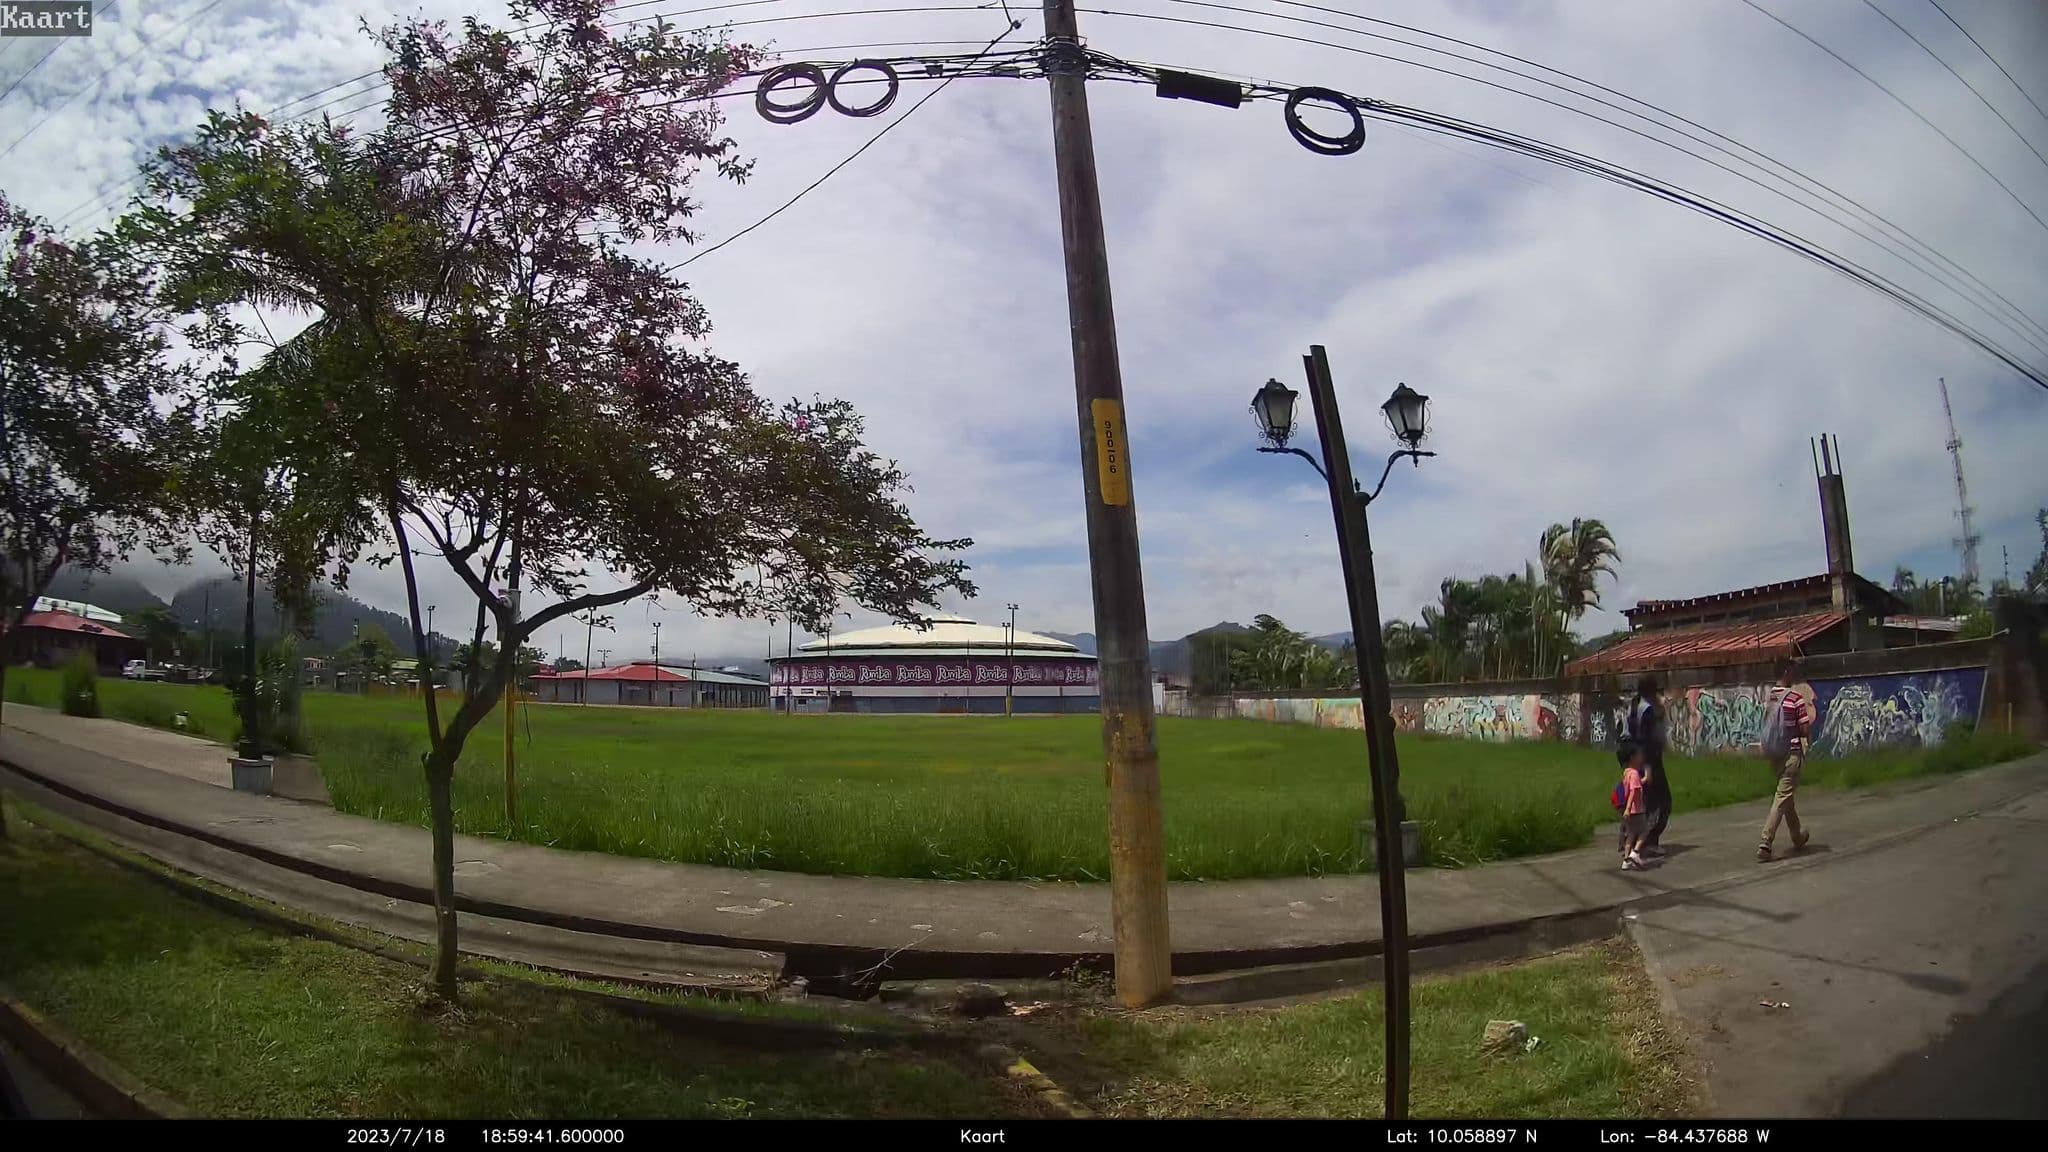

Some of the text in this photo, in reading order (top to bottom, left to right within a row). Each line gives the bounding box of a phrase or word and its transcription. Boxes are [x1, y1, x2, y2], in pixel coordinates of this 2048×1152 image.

[1104, 420, 1117, 474] 900-06
[827, 666, 856, 682] Rumba
[859, 665, 892, 683] Rumba
[896, 665, 931, 683] Rumba
[936, 665, 972, 683] Rumba
[976, 665, 1008, 683] Rumba
